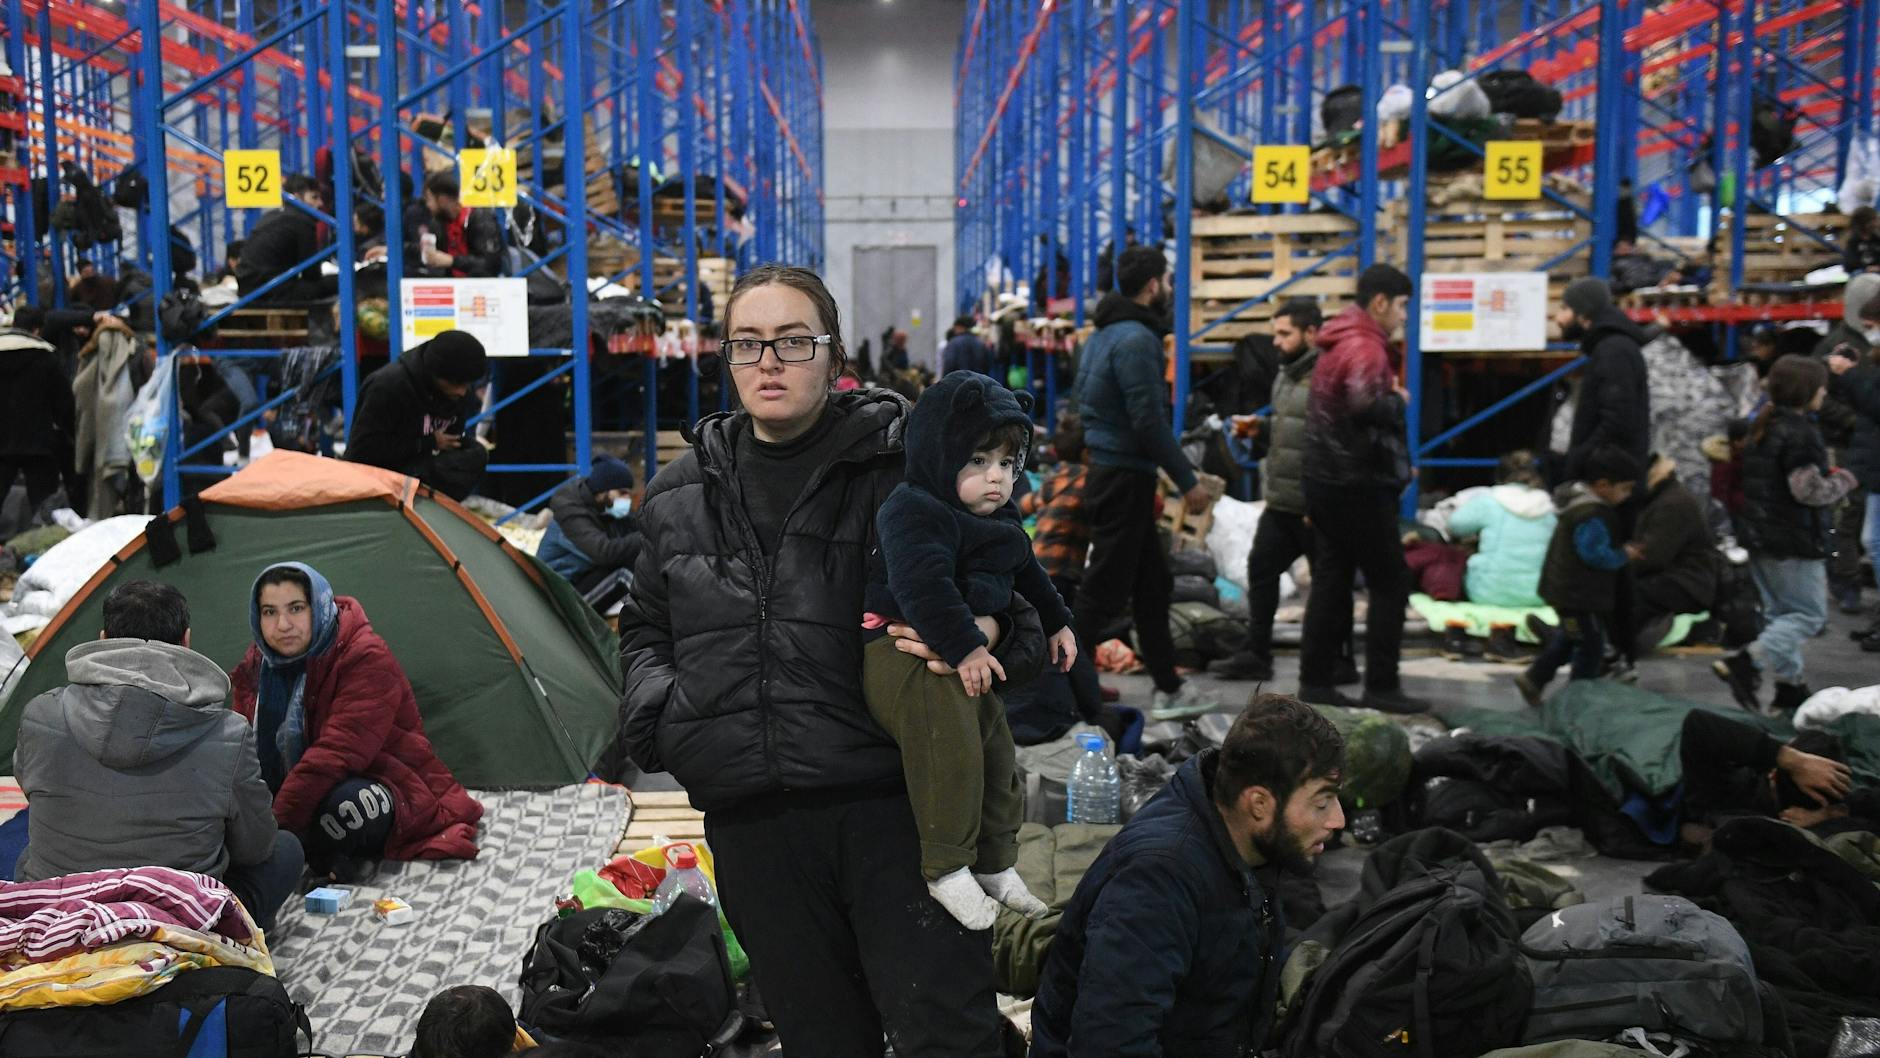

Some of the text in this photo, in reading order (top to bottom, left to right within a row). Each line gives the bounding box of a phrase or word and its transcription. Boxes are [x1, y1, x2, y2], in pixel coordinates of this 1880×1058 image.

[237, 165, 269, 193] 52
[474, 164, 505, 192] 53
[1264, 160, 1297, 189] 54
[1497, 157, 1530, 185] 55
